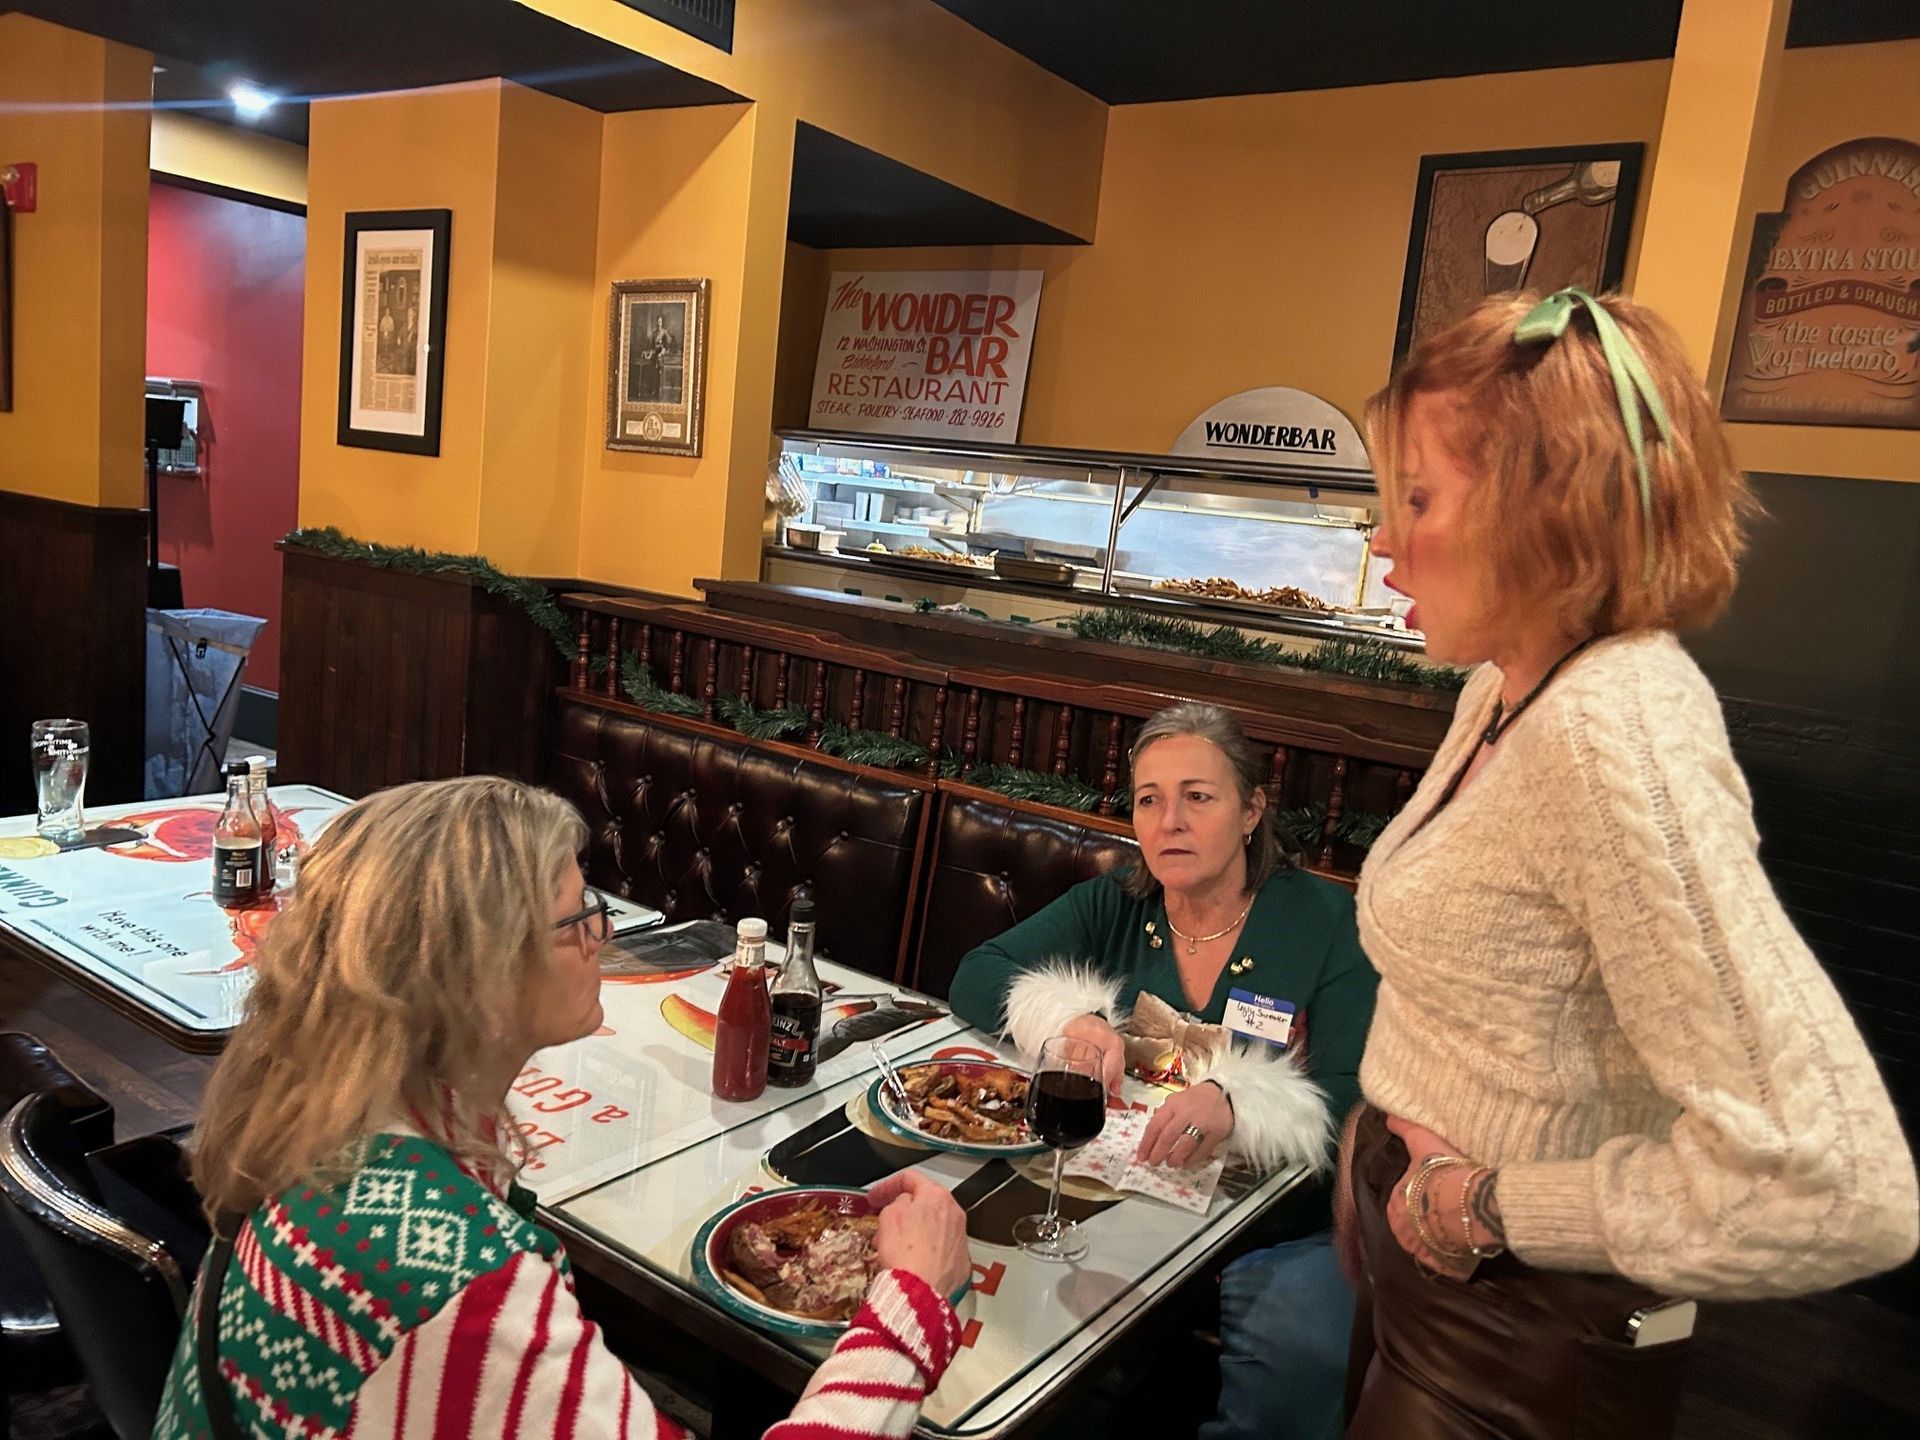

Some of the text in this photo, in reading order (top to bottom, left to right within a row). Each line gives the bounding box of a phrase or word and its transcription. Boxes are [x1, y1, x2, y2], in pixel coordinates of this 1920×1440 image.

[1770, 249, 1920, 272] EXTRA STOU
[831, 276, 1019, 338] The WONDER
[1766, 286, 1920, 316] BOTTLED & DRAUGH
[836, 336, 850, 351] 12
[852, 336, 915, 352] WASHINGTON
[841, 353, 896, 373] Biddeford
[925, 336, 1009, 379] BAR
[1770, 348, 1899, 375] of Ireland
[827, 373, 1009, 406] RESTAURANT
[815, 400, 851, 416] STEAK
[857, 403, 898, 419] POULTRY
[902, 405, 944, 422] SEAFOOD
[1205, 421, 1337, 450] WONDERBAR
[78, 924, 121, 942] with
[98, 910, 188, 957] Have this one
[1237, 1001, 1255, 1020] Ugly
[1254, 994, 1274, 1006] Hello
[772, 1017, 793, 1031] EINZ
